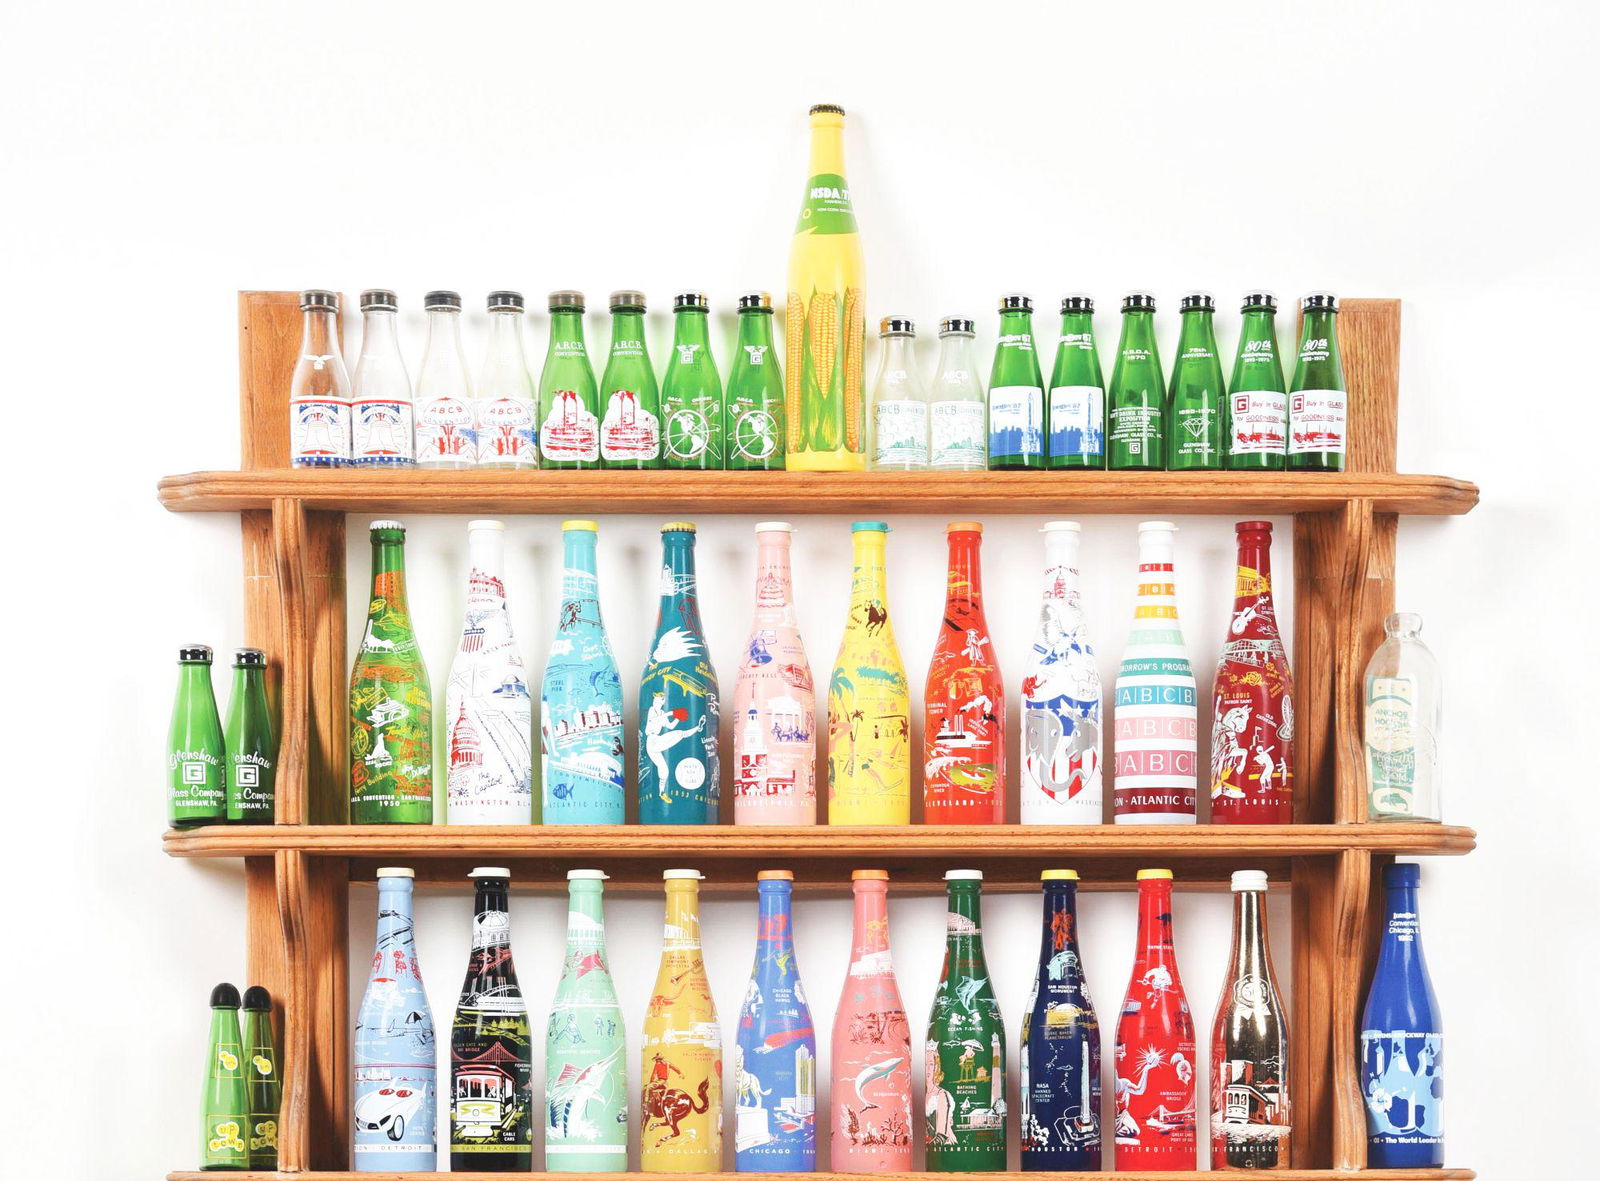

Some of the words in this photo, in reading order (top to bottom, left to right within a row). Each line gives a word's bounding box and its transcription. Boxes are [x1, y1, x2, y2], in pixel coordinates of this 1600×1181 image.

[810, 186, 841, 199] NSDA
[1245, 339, 1272, 351] 80th
[1303, 338, 1328, 351] 80th
[1131, 795, 1180, 806] ATLANTIC
